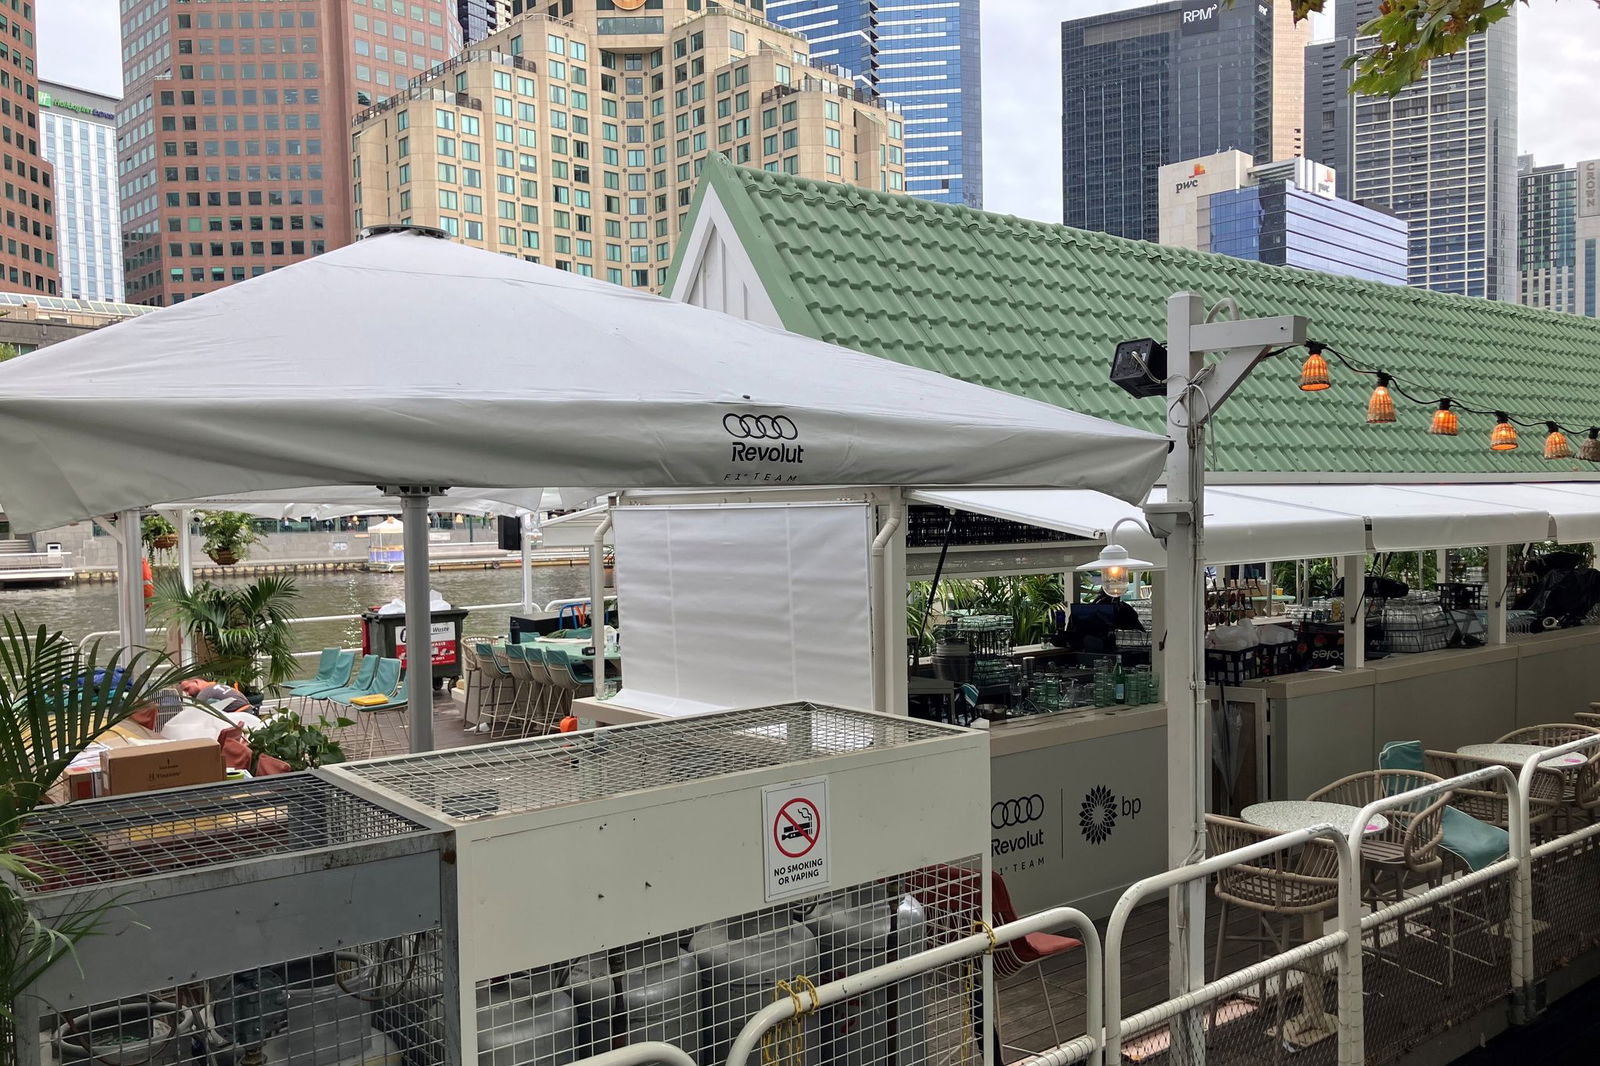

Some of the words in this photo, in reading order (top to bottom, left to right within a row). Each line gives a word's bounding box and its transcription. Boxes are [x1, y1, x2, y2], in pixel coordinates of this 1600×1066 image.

[1175, 179, 1199, 193] pwc
[1585, 162, 1596, 208] CROWN
[731, 441, 804, 463] Revolut
[754, 472, 798, 481] TEAM
[1121, 796, 1142, 819] bp
[991, 828, 1045, 857] Revolut
[774, 867, 786, 877] NO
[787, 858, 823, 873] SMOKING
[1013, 857, 1045, 873] TEAM
[778, 876, 790, 886] OR
[791, 869, 820, 882] VAPING
